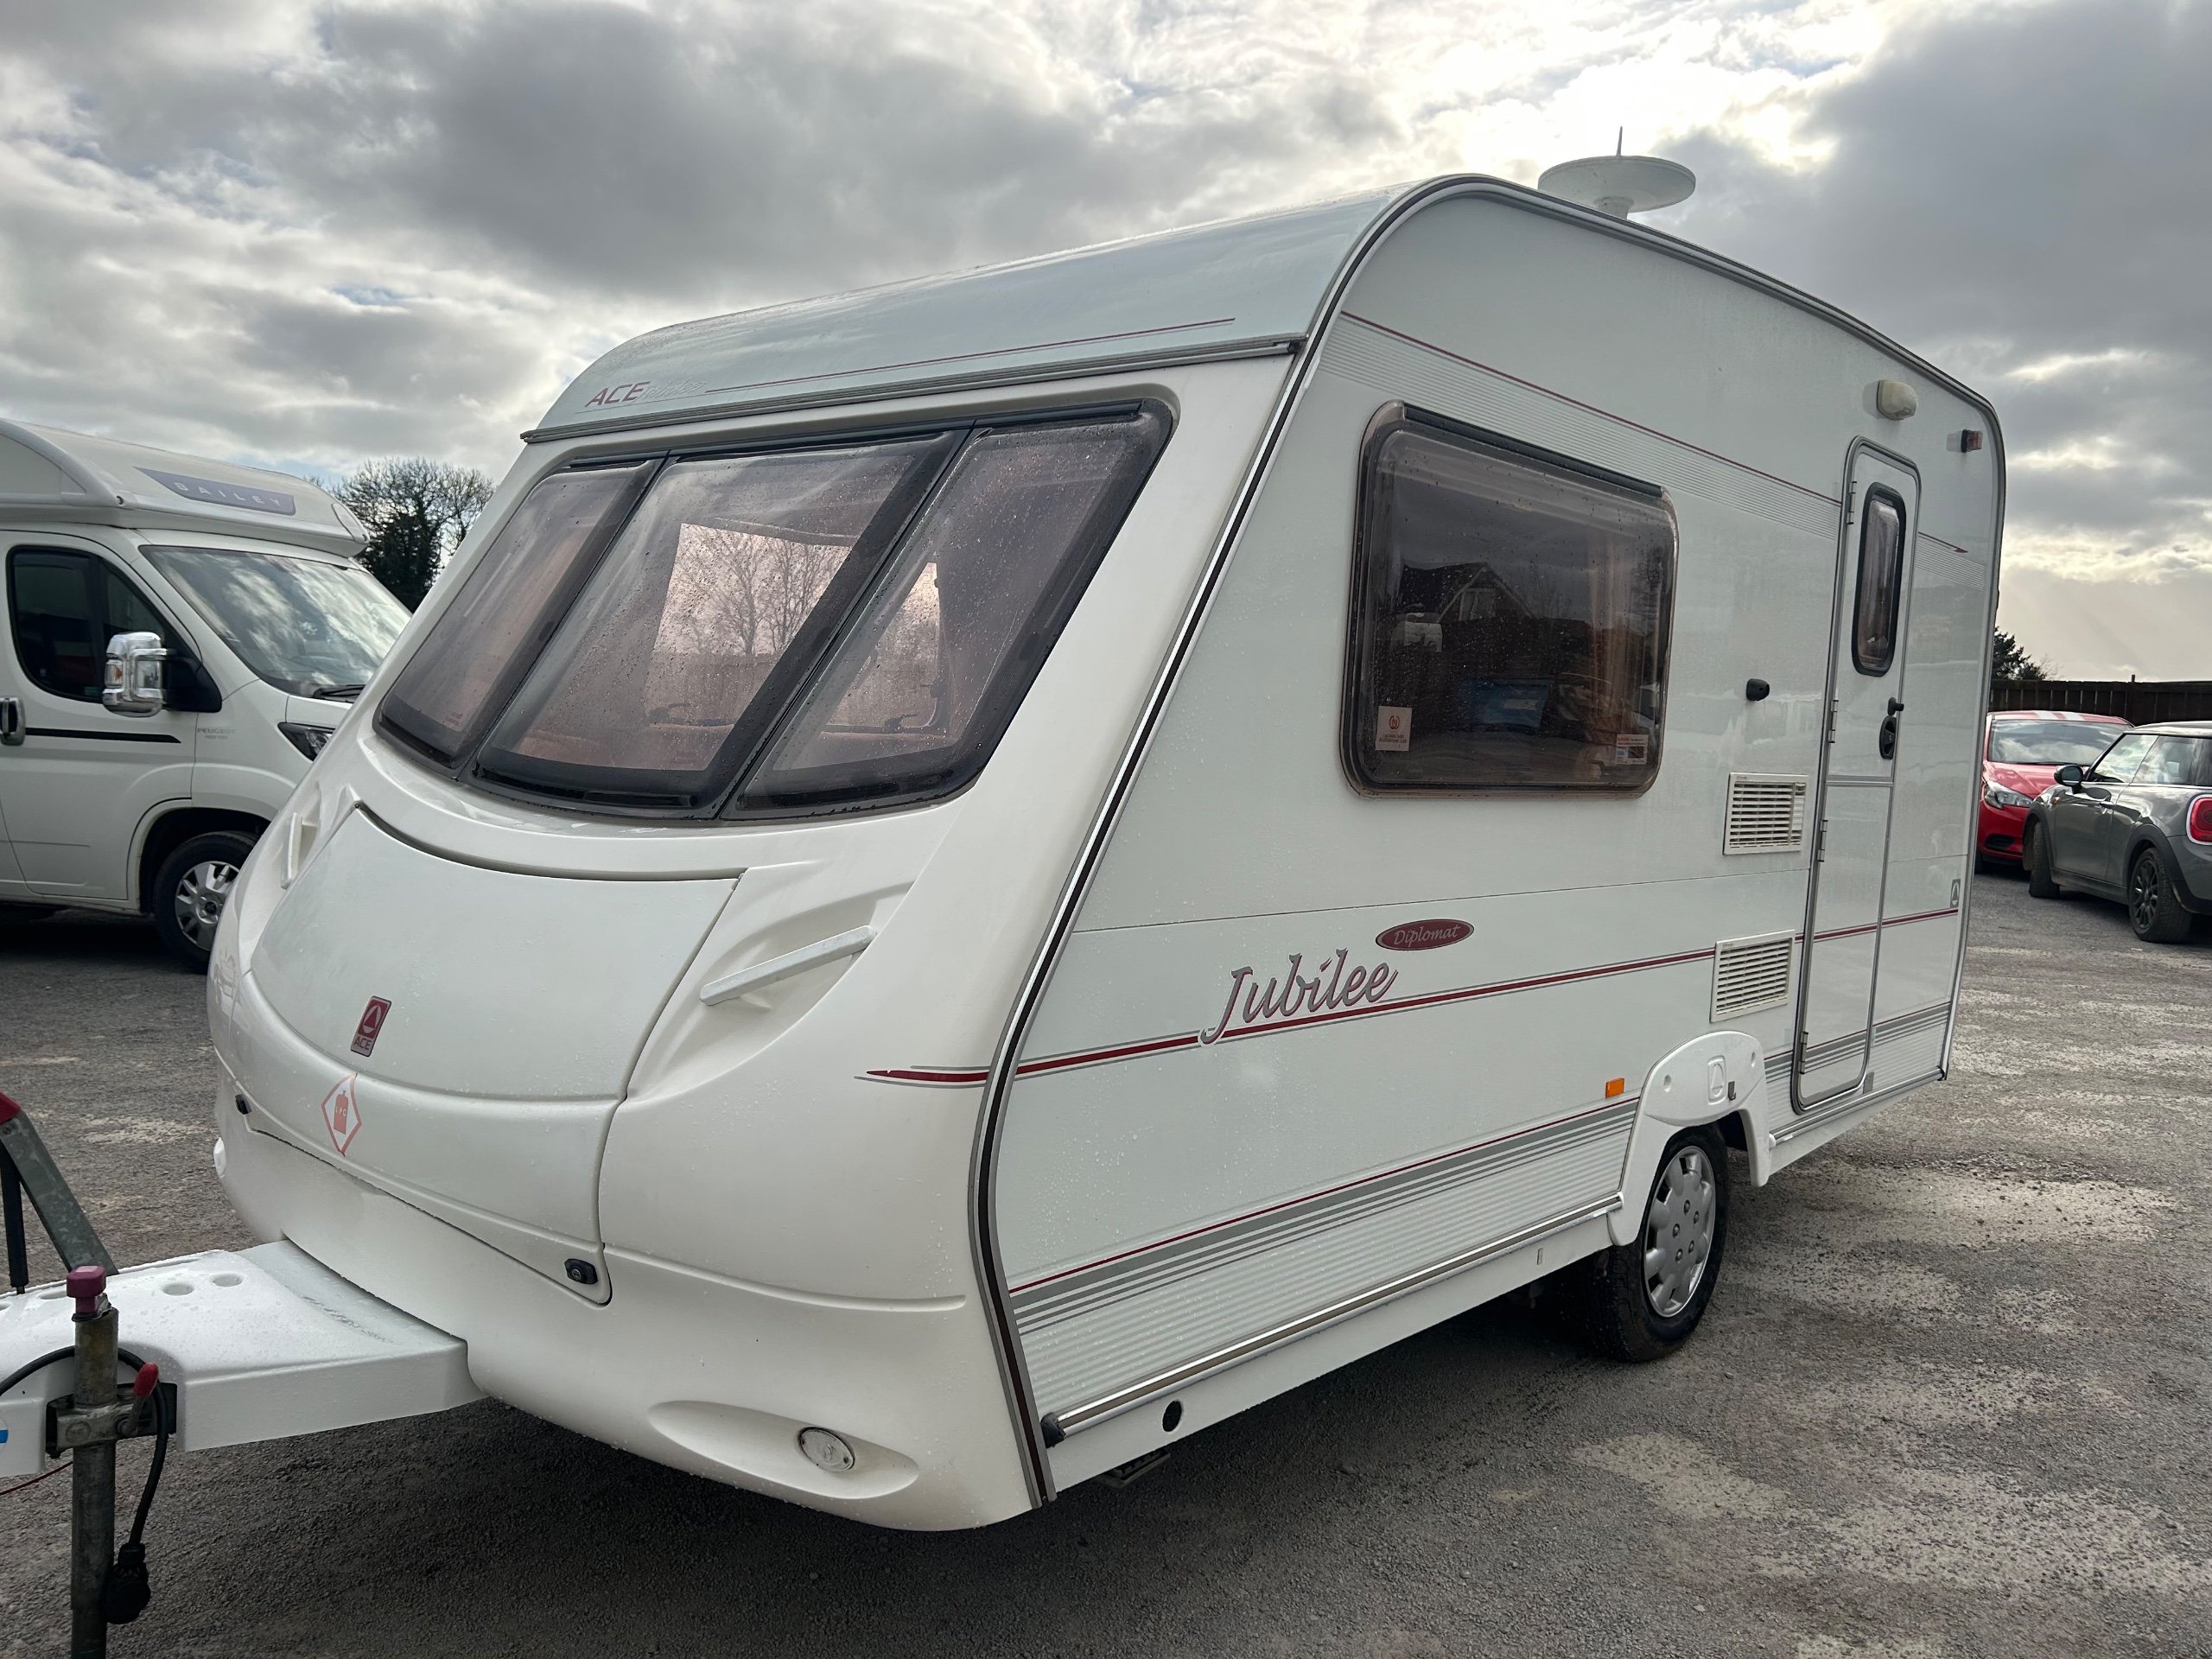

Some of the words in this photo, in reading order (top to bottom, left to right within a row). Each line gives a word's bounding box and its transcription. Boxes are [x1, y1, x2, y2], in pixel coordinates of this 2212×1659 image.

[584, 381, 651, 407] ACE
[175, 482, 281, 505] BAILEY
[1394, 925, 1461, 947] Diplomat
[1200, 947, 1399, 1045] Jubilee
[353, 1037, 372, 1050] ACE
[335, 1107, 346, 1116] LPG
